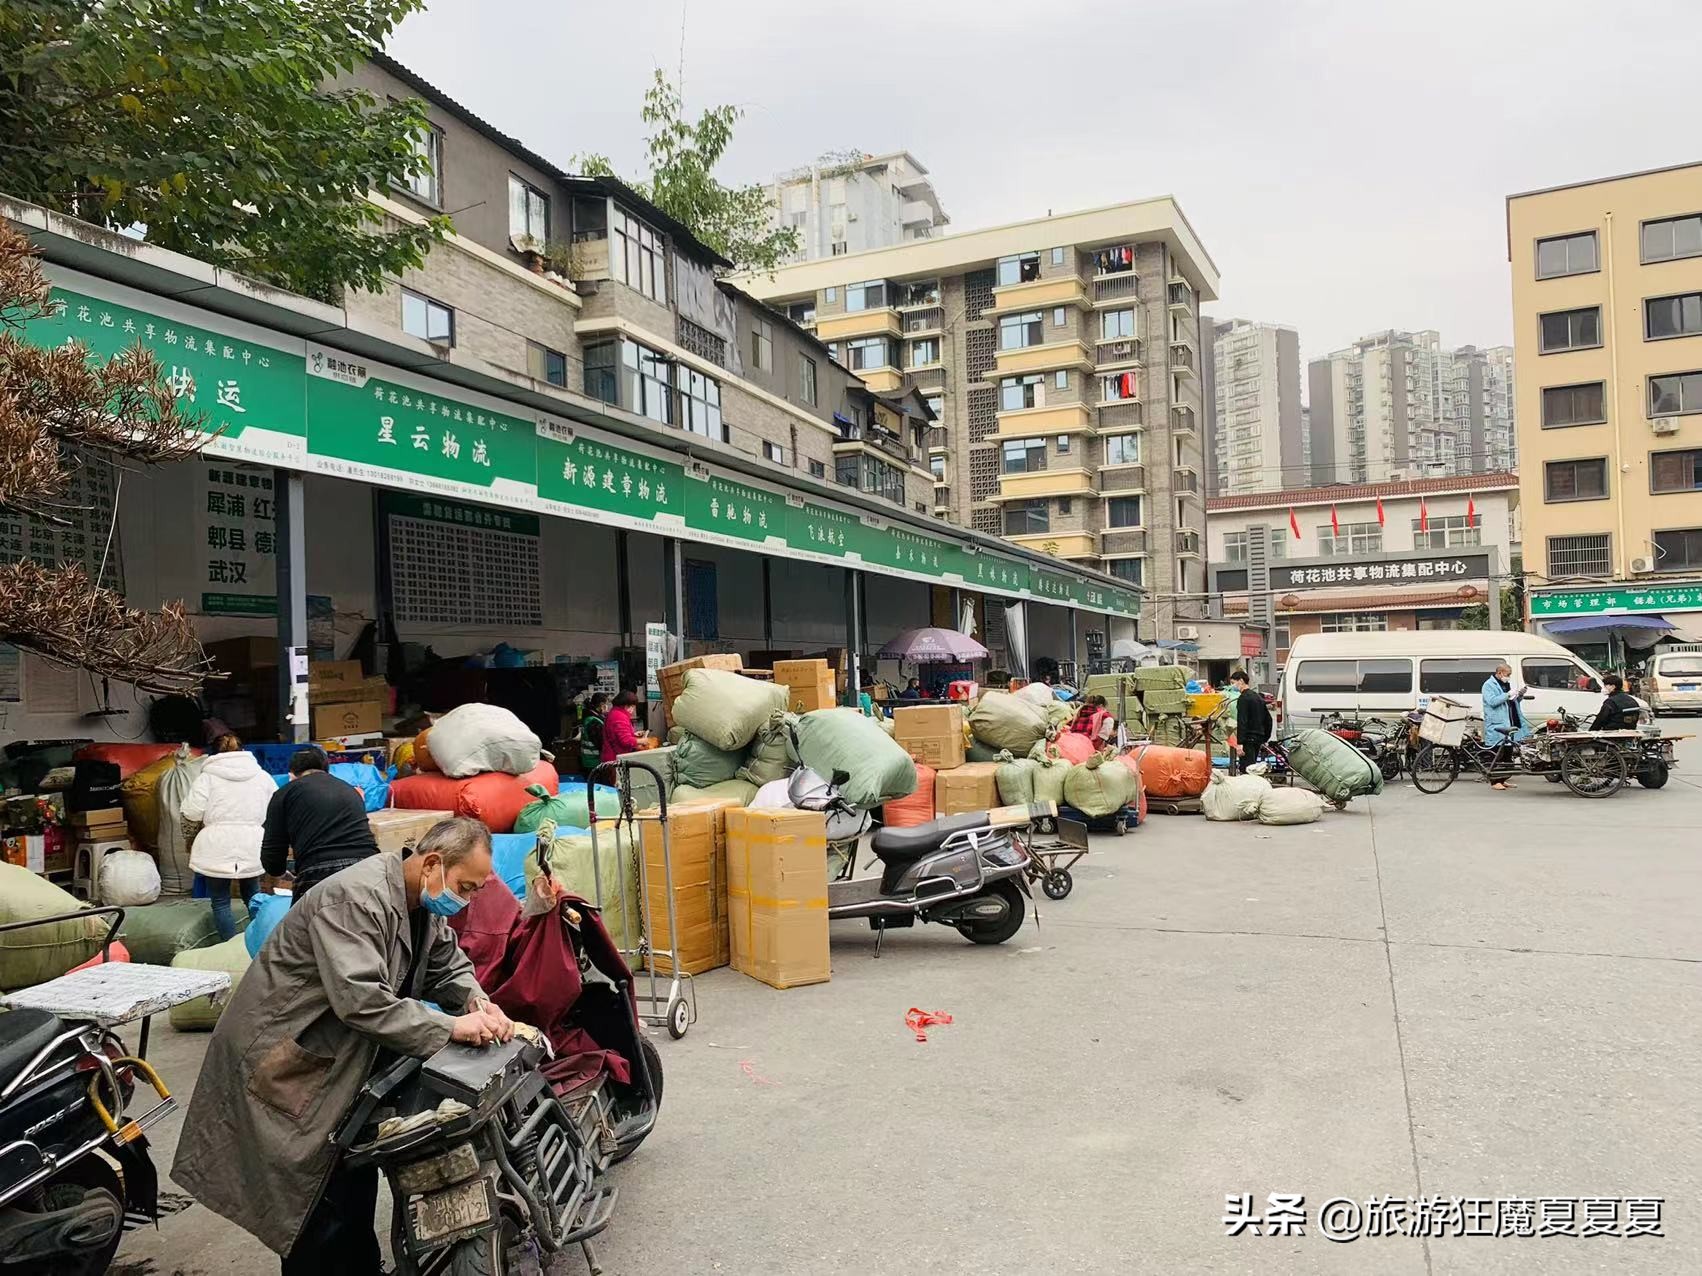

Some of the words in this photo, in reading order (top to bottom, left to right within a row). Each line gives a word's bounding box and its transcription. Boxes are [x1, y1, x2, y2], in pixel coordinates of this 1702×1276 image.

[48, 298, 270, 366] 荷花池共享物流集配中心
[374, 386, 508, 431] 荷花池共享物流集配中心
[377, 416, 491, 467] 星云物流
[563, 456, 668, 505] 新源建章物流
[207, 491, 245, 517] 犀浦
[253, 498, 277, 521] 红
[207, 525, 246, 551] 郫县
[254, 531, 278, 555] 德
[208, 560, 248, 584] 武汉
[1290, 560, 1468, 584] 荷花池共享物流集配中心
[1542, 596, 1616, 610] 市场管理部
